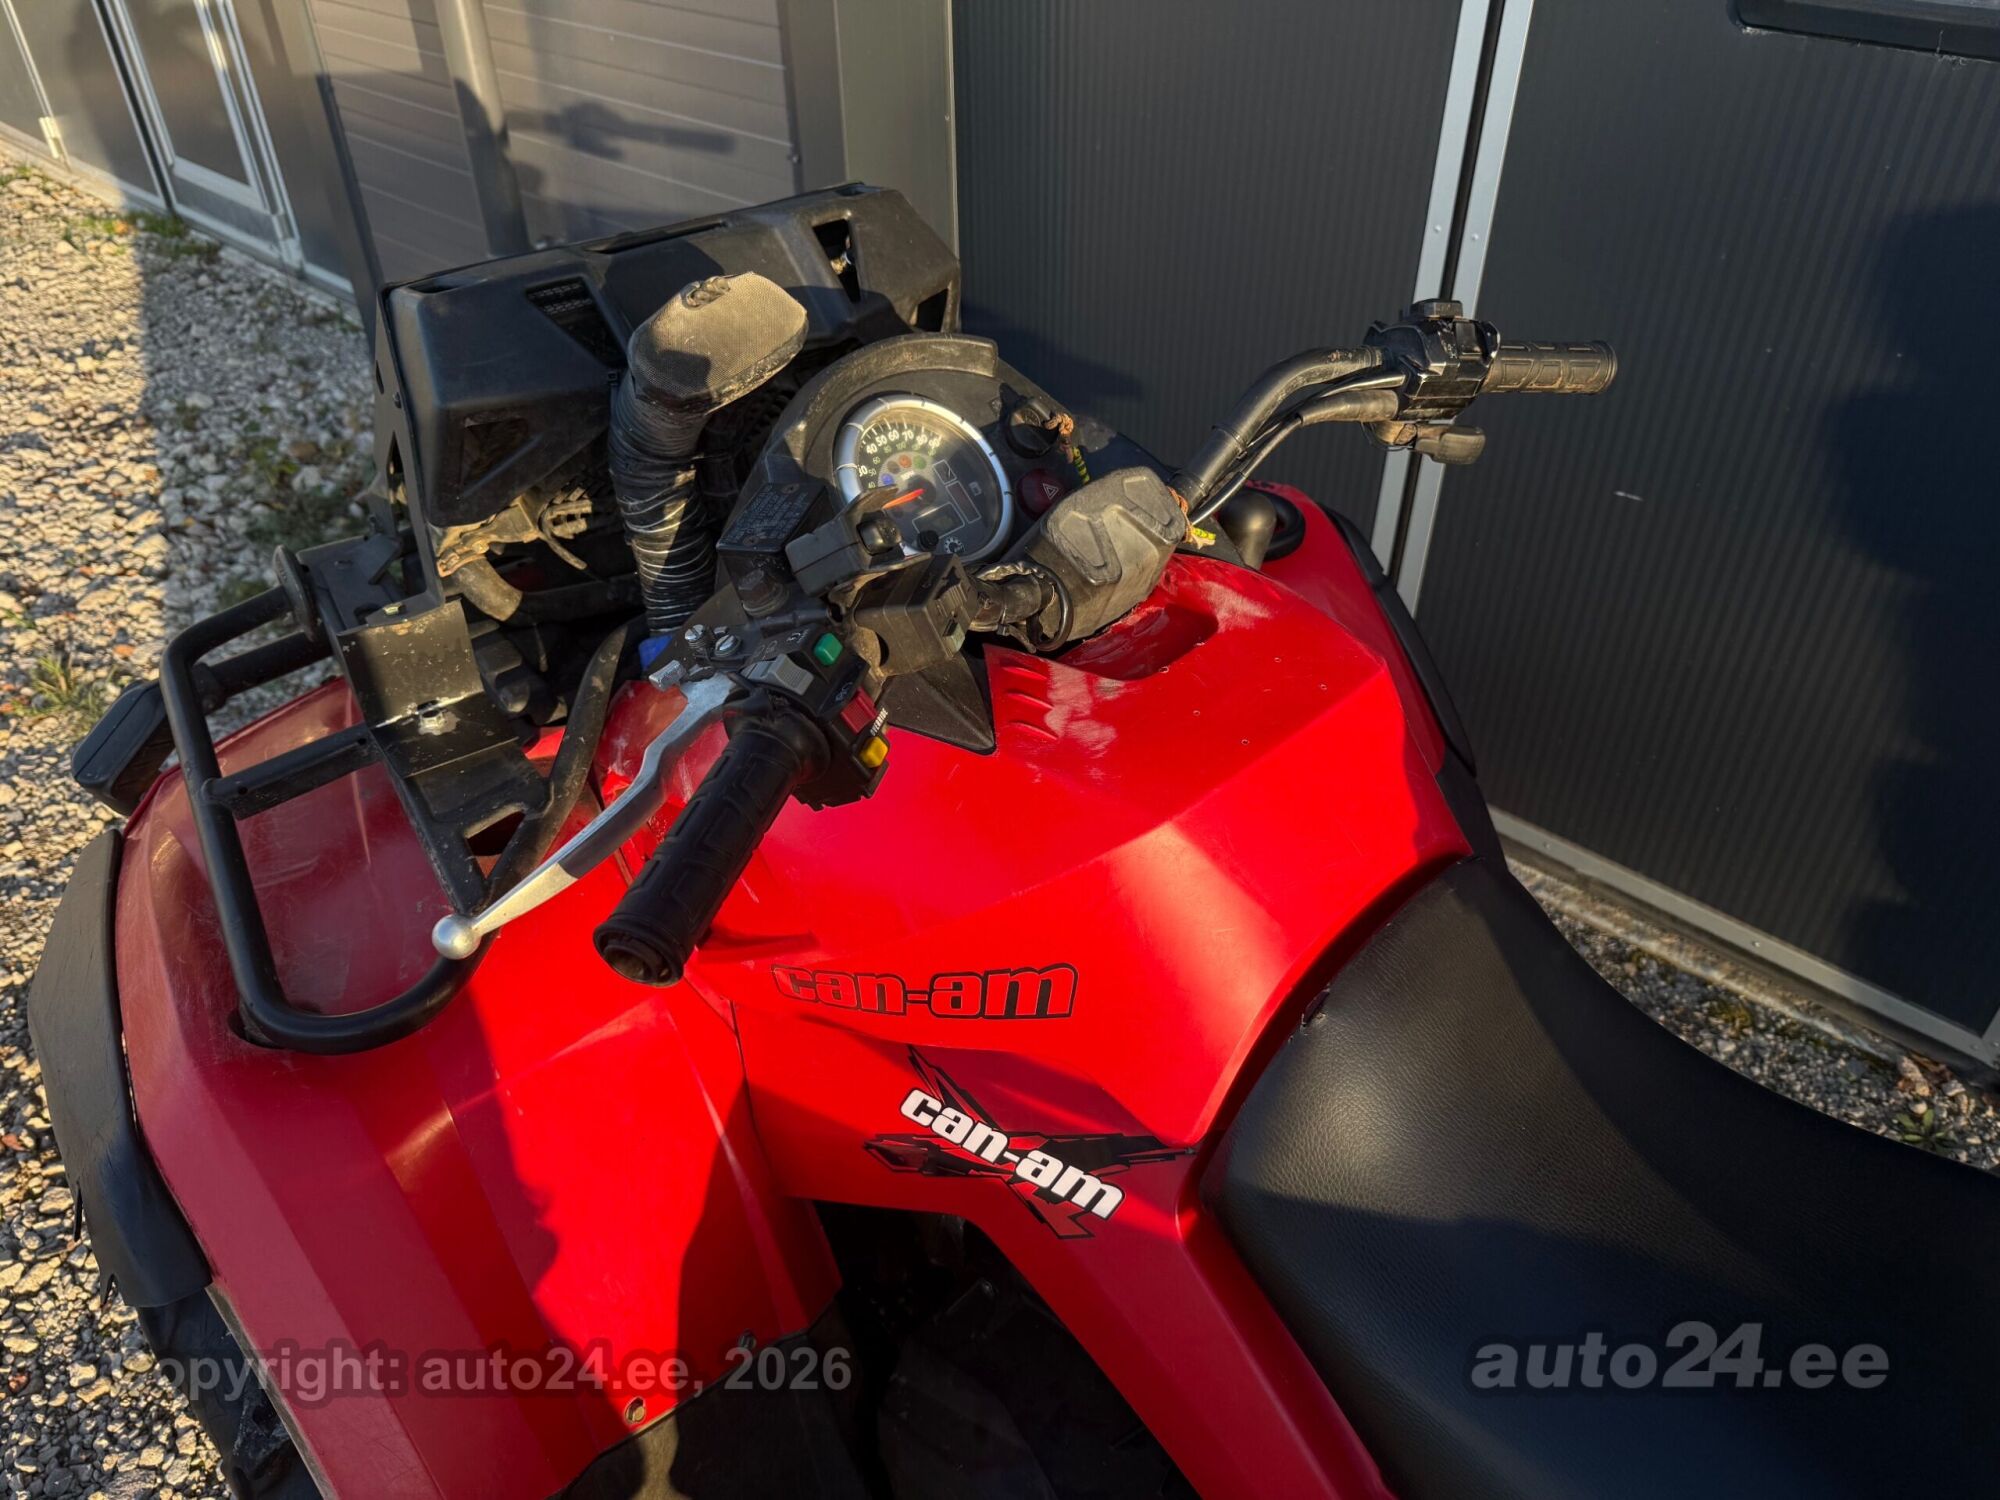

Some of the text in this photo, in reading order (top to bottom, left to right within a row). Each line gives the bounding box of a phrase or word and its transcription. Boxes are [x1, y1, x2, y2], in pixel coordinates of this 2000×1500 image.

[866, 444, 878, 454] 40
[876, 434, 887, 447] 50
[888, 428, 900, 441] 60
[902, 429, 914, 441] 70
[916, 434, 928, 445] 80
[928, 438, 940, 450] 90
[771, 963, 1078, 1019] can-am
[900, 1088, 1126, 1220] can-am
